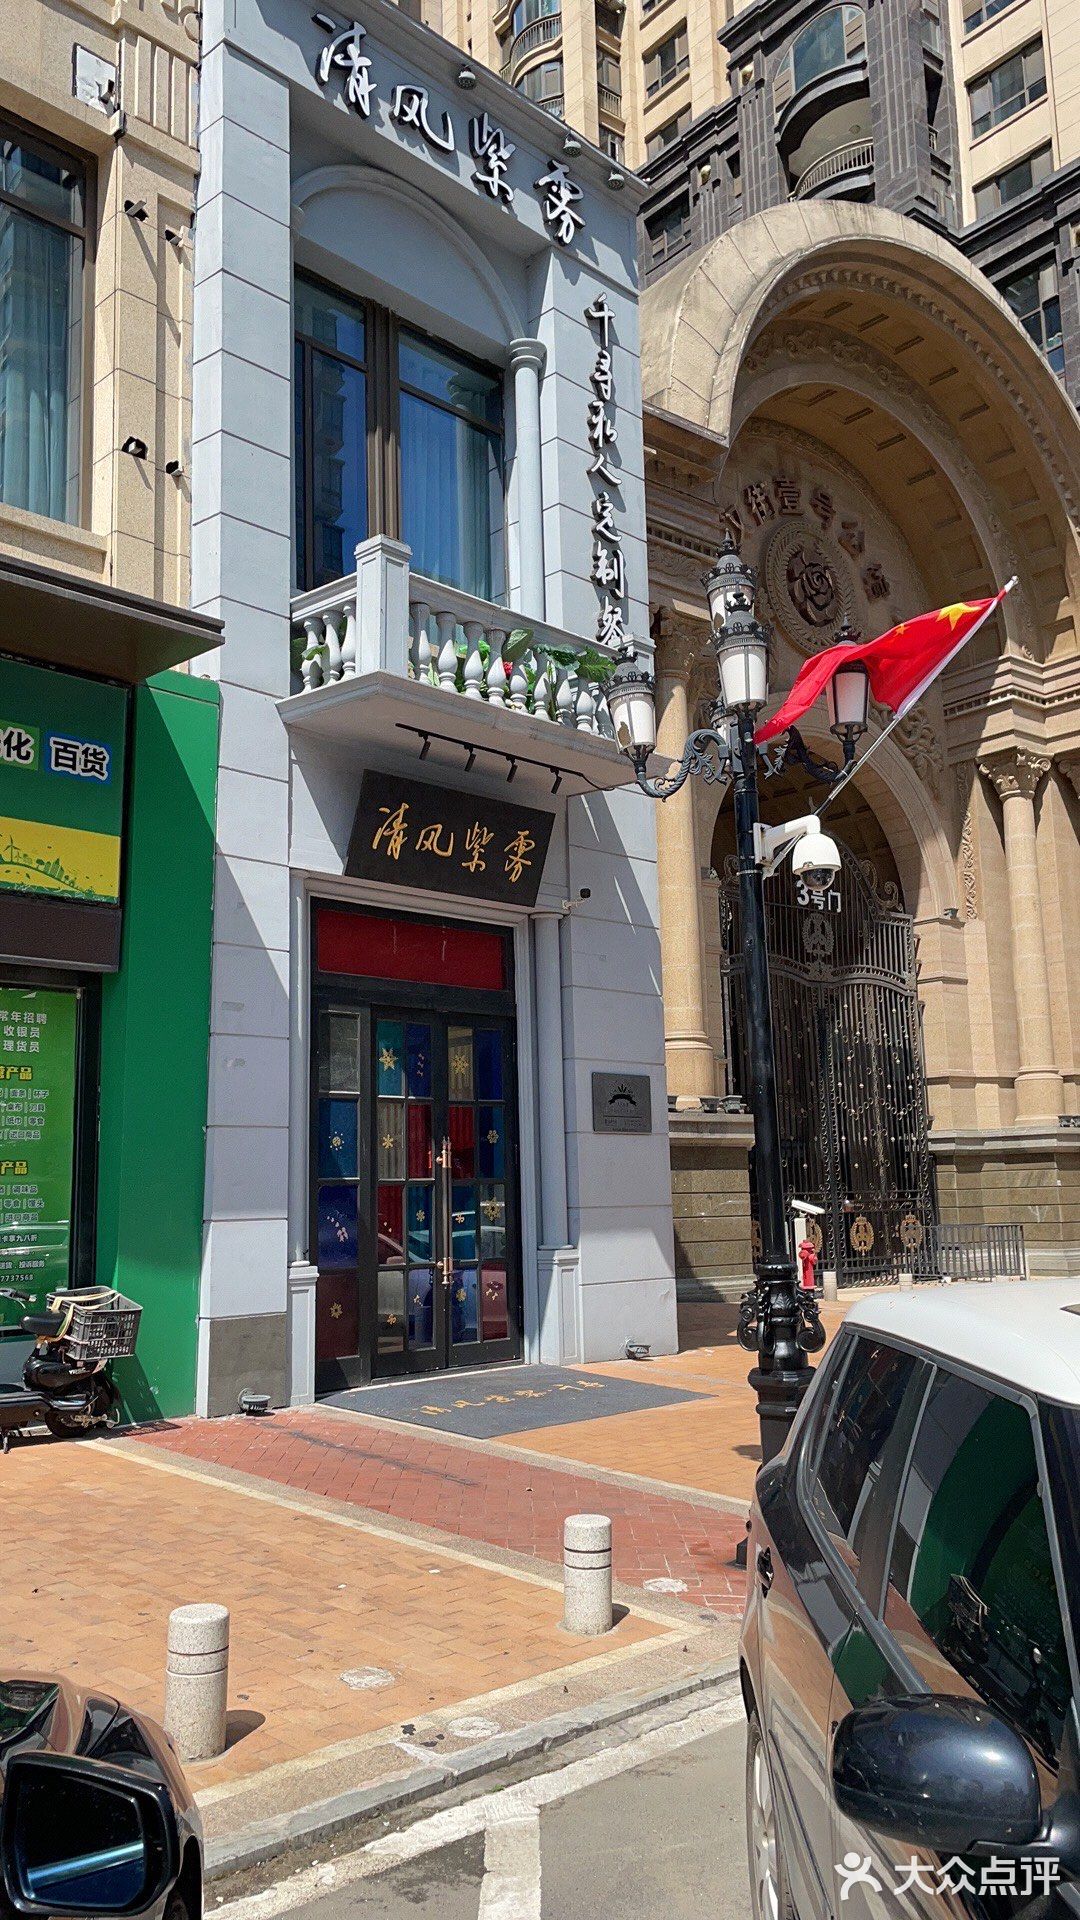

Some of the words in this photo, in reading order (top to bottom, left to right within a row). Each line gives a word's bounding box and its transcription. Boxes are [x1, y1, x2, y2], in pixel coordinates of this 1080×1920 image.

[0, 730, 33, 762] 化
[51, 739, 107, 778] 百货
[796, 880, 842, 913] 3号门
[0, 1010, 47, 1025] 常年招聘
[4, 1025, 40, 1038] 收银员
[3, 1040, 40, 1053] 理货员
